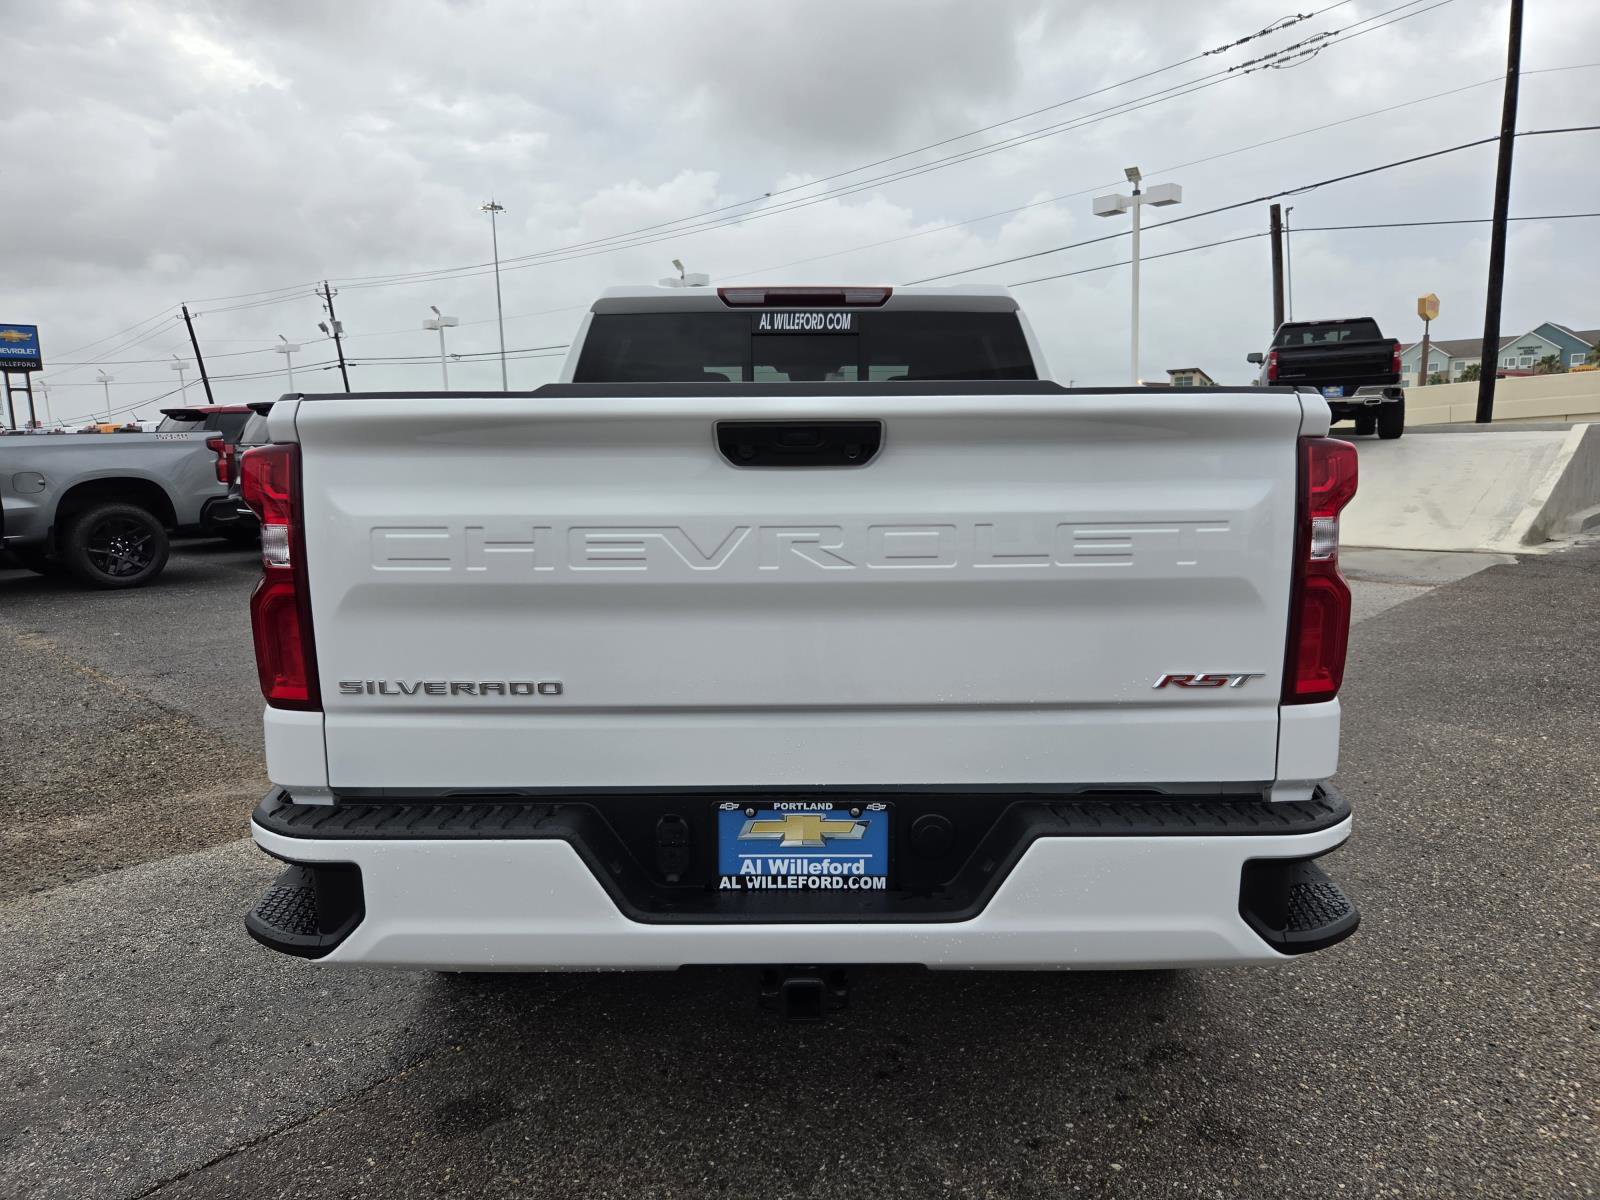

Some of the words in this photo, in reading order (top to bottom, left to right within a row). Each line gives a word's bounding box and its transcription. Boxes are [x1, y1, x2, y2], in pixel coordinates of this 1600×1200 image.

[759, 313, 771, 329] AL
[773, 313, 824, 329] WILLEFORD
[827, 313, 851, 329] COM
[370, 520, 1230, 571] CHEVROLET
[338, 680, 563, 696] SILVERADO
[1152, 673, 1265, 688] RST
[773, 802, 833, 811] PORTLAND
[740, 859, 762, 875] Al
[768, 859, 865, 875] Willeford
[719, 876, 741, 889] AL
[746, 876, 886, 890] WILLEFORD.COM
